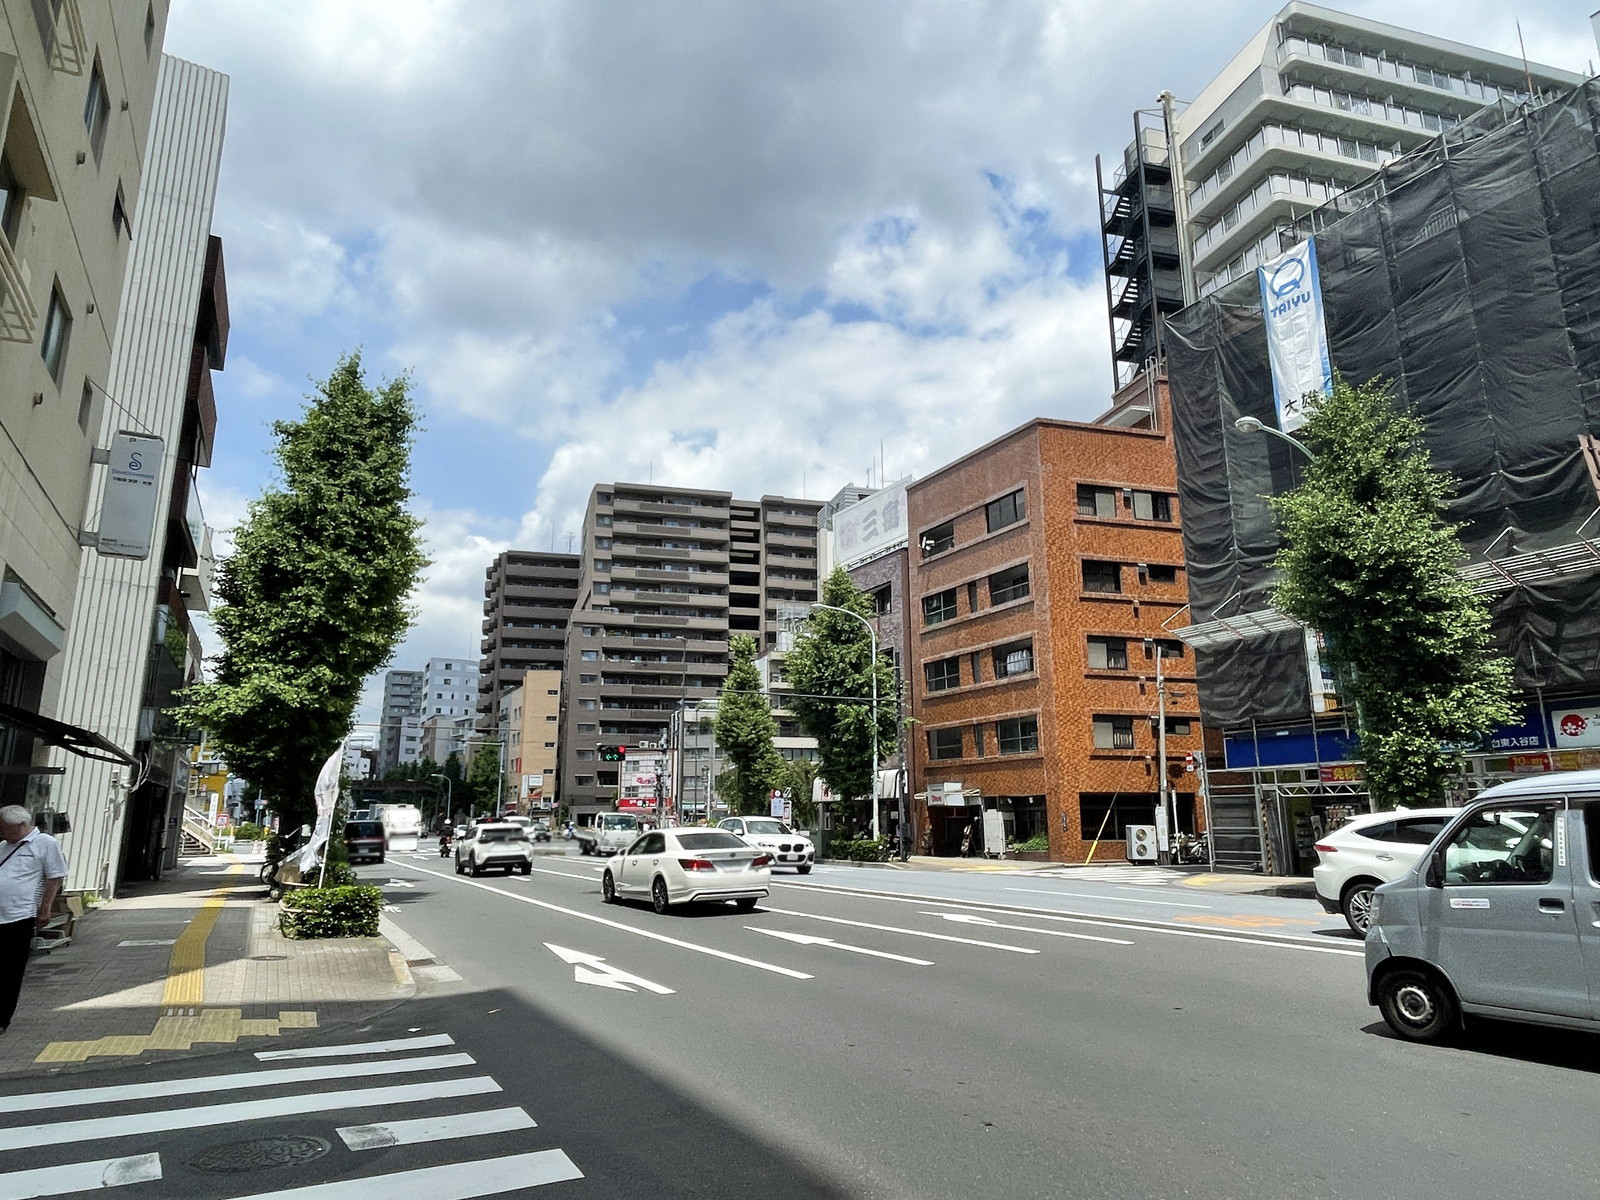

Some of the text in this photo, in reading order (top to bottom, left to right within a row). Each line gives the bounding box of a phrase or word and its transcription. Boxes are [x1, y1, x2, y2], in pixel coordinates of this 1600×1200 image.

[1270, 290, 1310, 318] TAIYU
[1490, 736, 1539, 748] 台東入谷店
